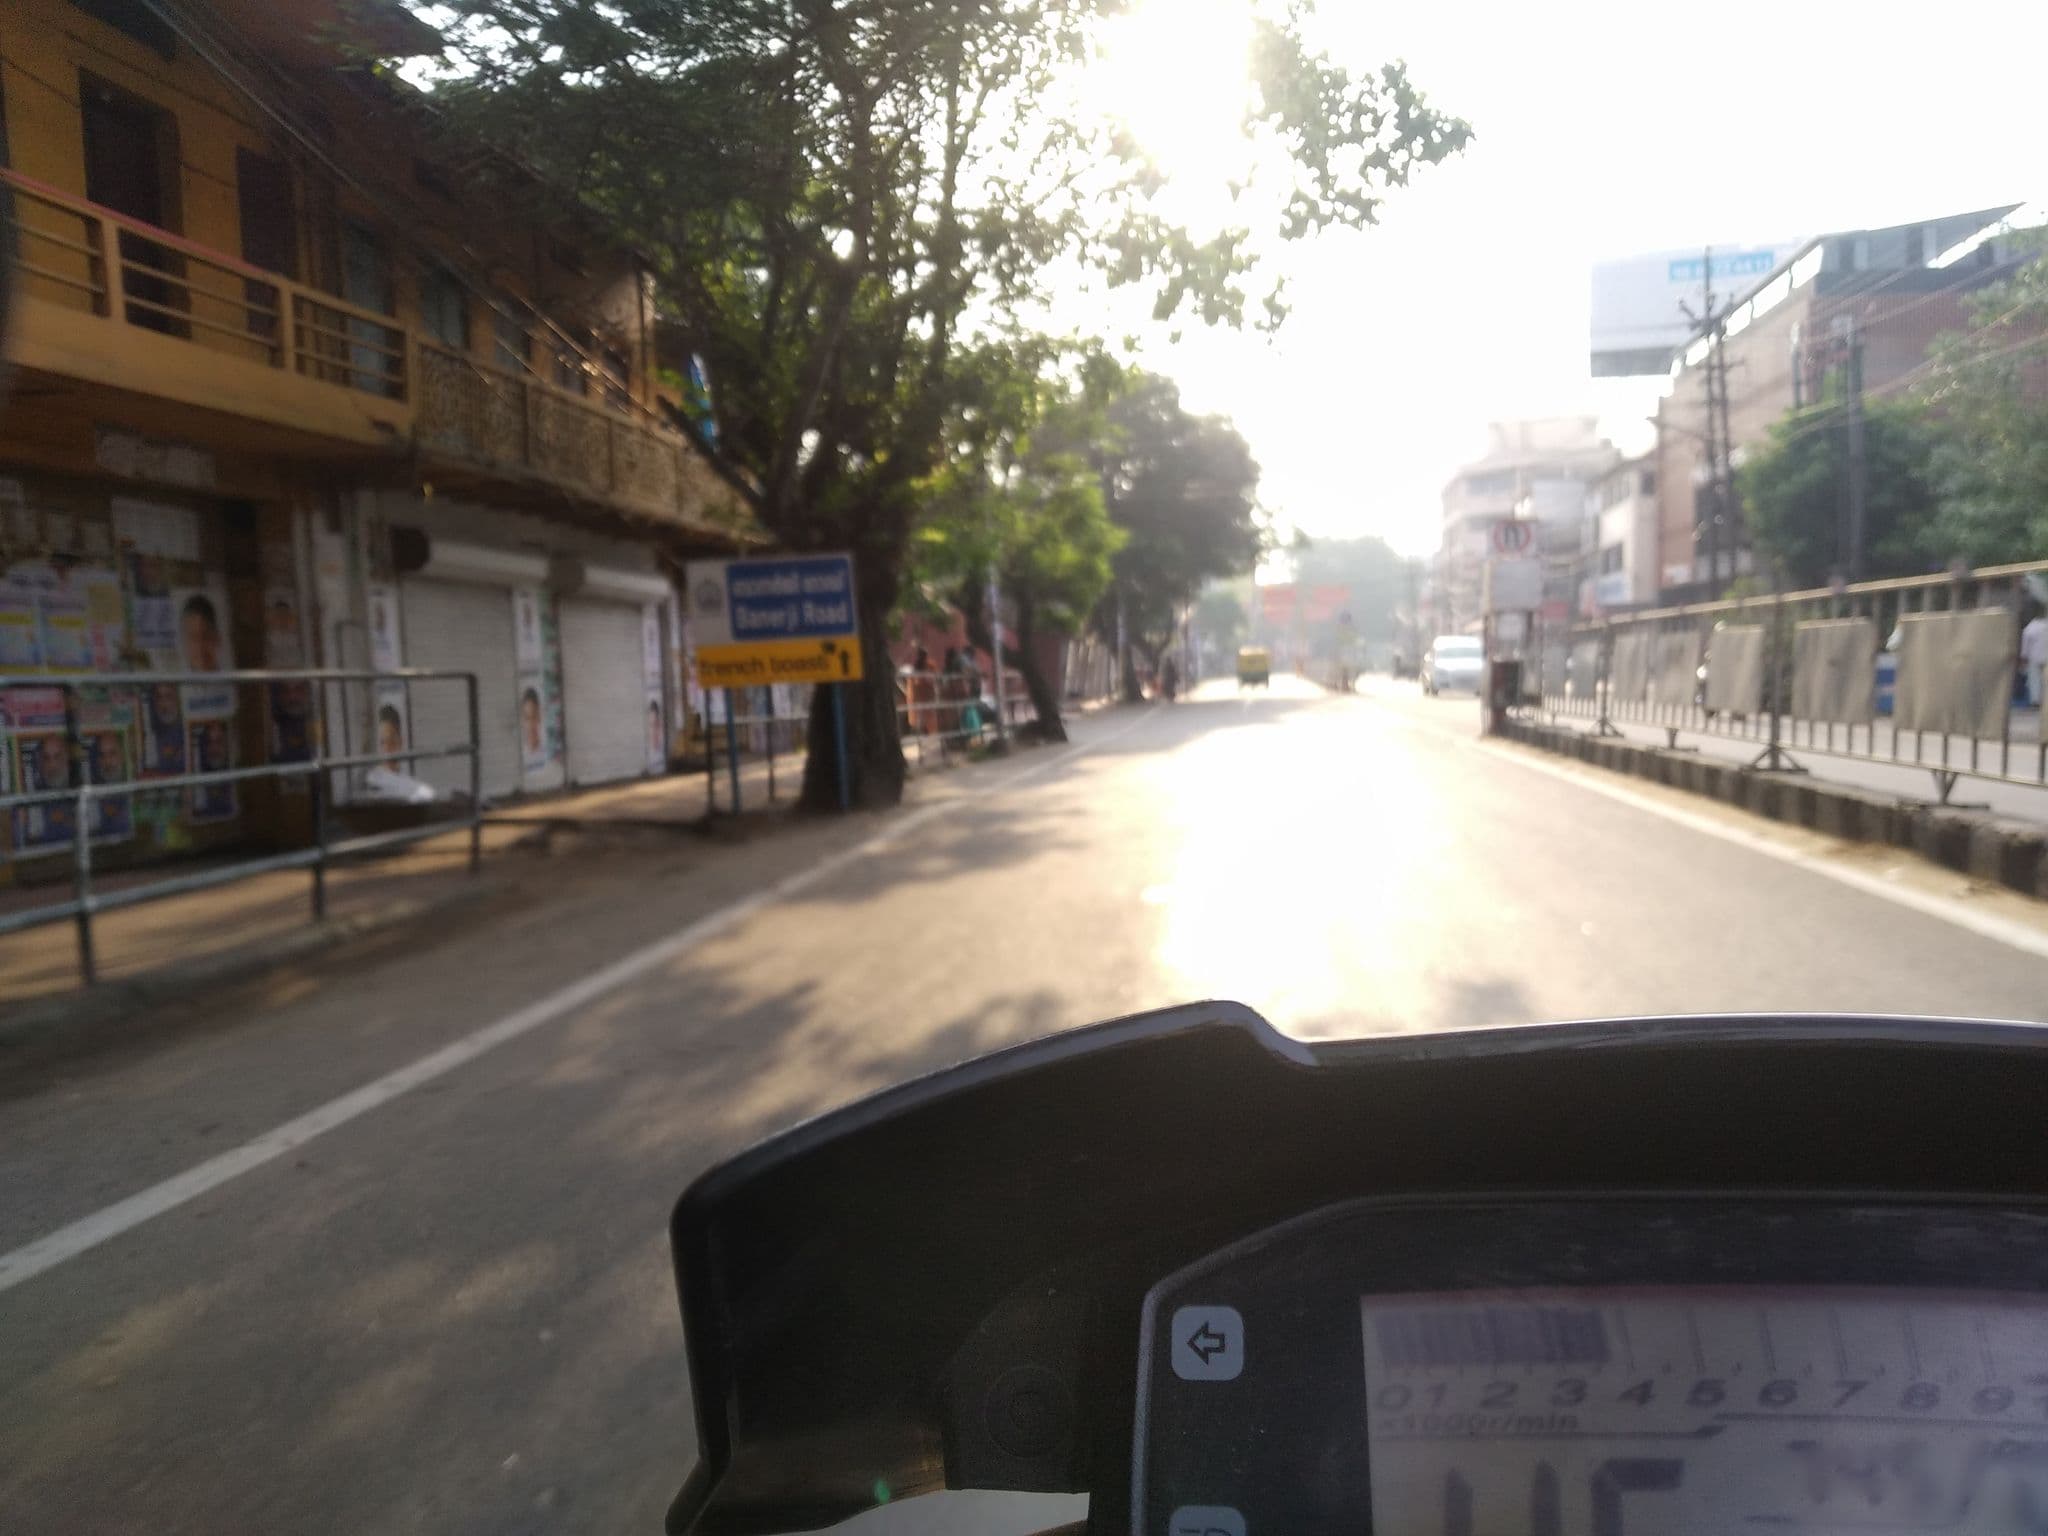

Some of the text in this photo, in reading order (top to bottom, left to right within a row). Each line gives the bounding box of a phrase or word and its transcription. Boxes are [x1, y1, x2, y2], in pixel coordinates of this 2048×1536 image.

[803, 600, 848, 625] Road
[1377, 1384, 1413, 1411] 0
[1425, 1382, 1449, 1408] 1
[1479, 1380, 1519, 1408] 2
[1550, 1378, 1588, 1406] 3
[1616, 1379, 1655, 1406] 4
[1685, 1379, 1727, 1407] 5
[1758, 1379, 1798, 1407] 6
[1833, 1379, 1870, 1408] 7
[1898, 1382, 1941, 1411] 8
[1972, 1386, 2016, 1413] 9
